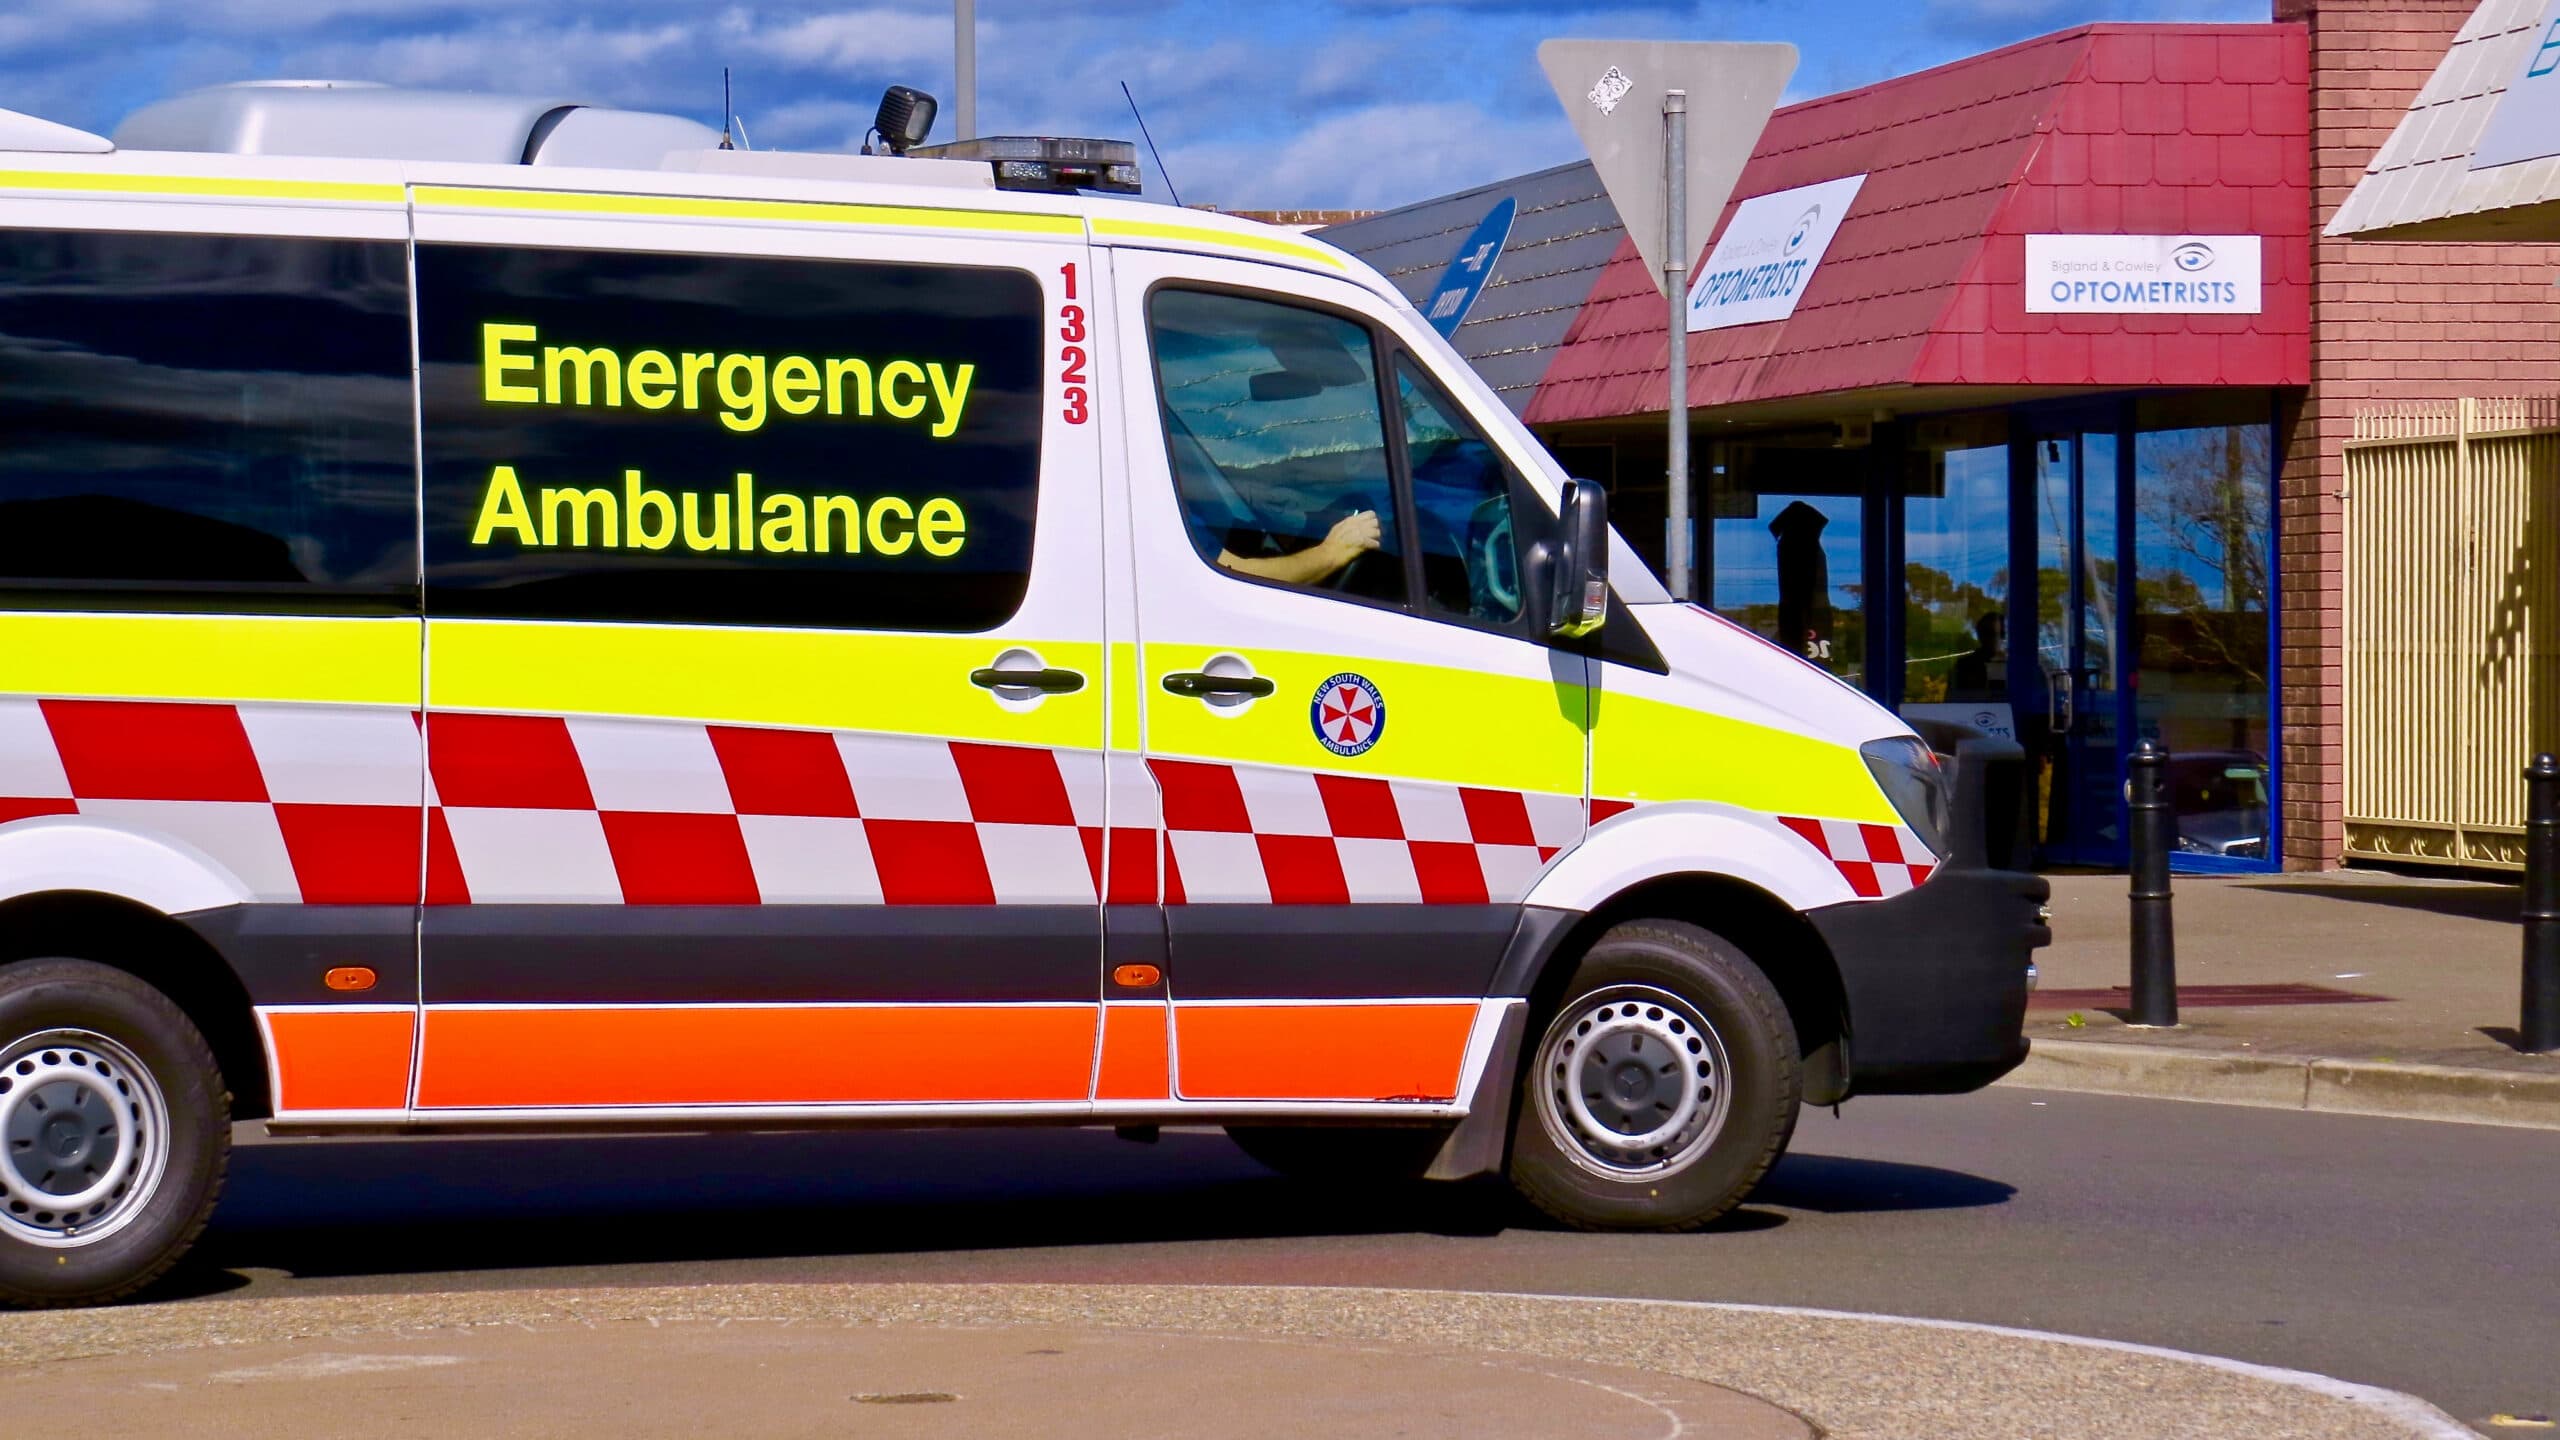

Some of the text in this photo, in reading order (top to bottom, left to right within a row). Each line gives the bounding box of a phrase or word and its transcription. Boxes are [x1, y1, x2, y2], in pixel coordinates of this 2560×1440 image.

[2051, 260, 2161, 273] Bigland & Cowley
[1694, 258, 1808, 311] OPTOMETRISTS
[2051, 281, 2236, 304] OPTOMETRISTS
[483, 323, 975, 438] Emergency
[471, 465, 967, 557] Ambulance
[1314, 674, 1384, 709] NEW SOUTH WALES
[1320, 736, 1375, 755] AMBULANCE
